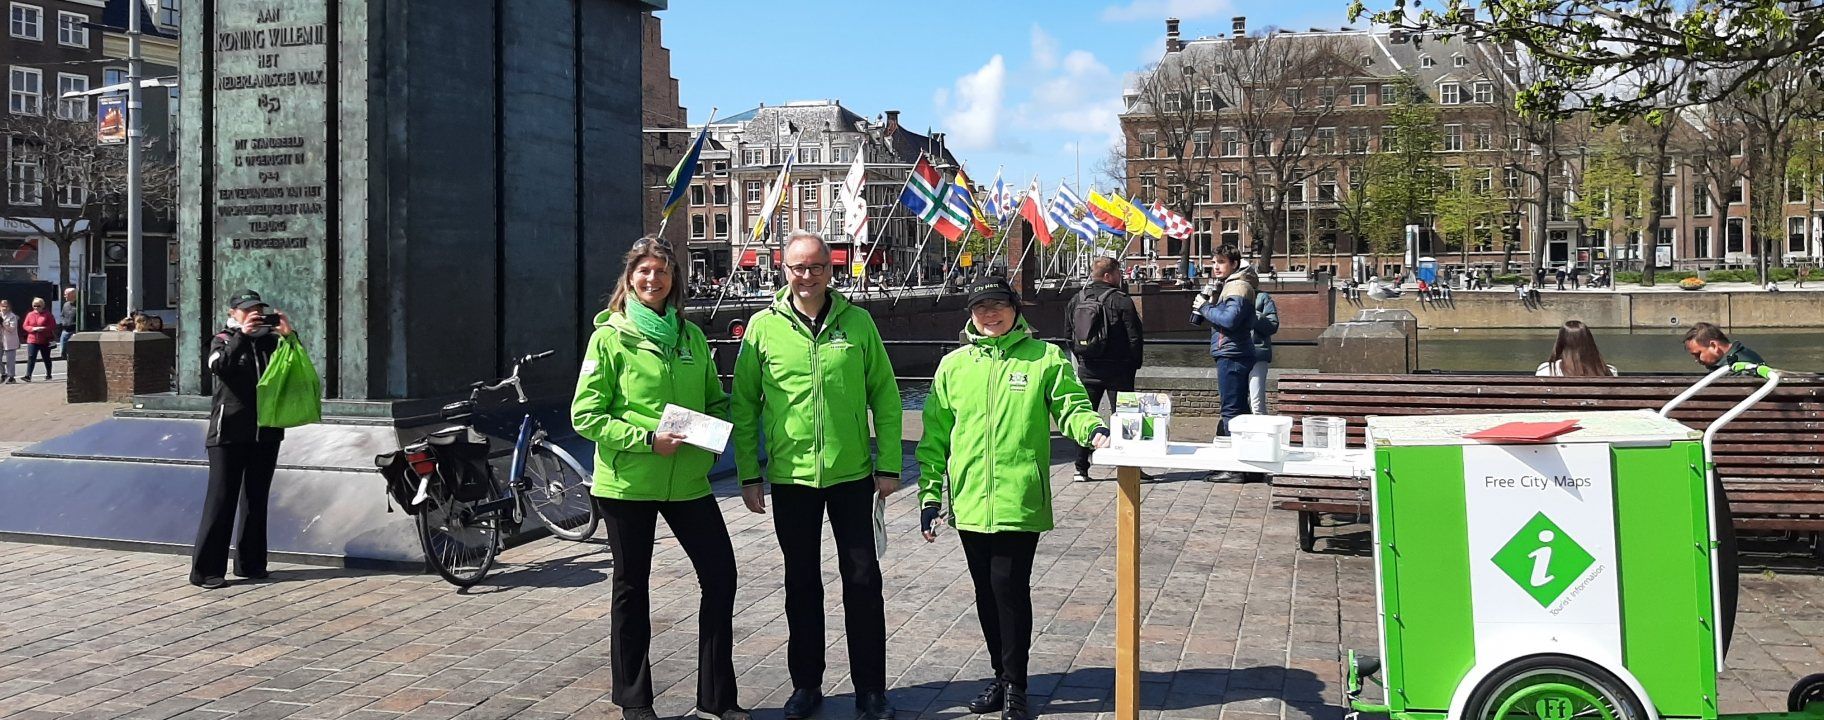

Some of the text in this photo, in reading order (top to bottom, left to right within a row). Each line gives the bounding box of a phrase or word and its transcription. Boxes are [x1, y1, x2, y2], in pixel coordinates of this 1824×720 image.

[257, 8, 280, 23] AAN
[219, 29, 265, 51] KONING
[269, 25, 314, 47] WILLEM
[258, 54, 279, 68] HET
[248, 221, 287, 233] TILBURG
[1485, 475, 1592, 491] Free City Maps
[1549, 564, 1606, 617] Tourist Information
